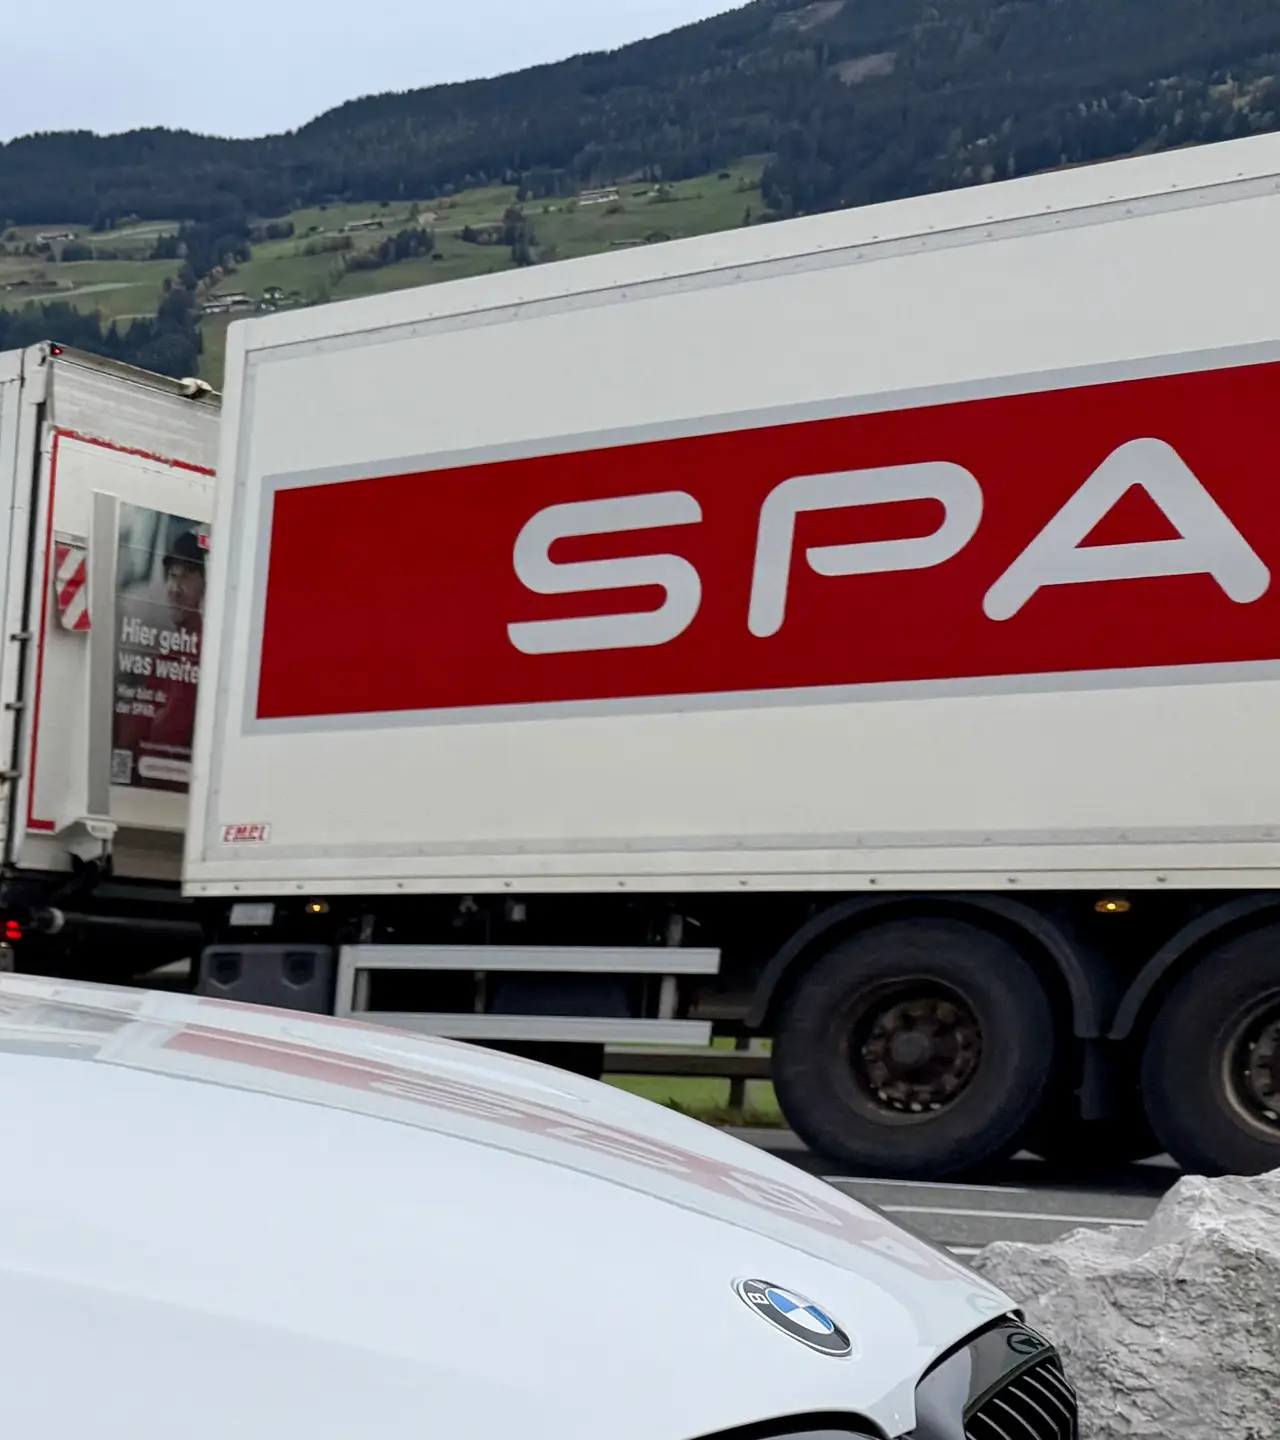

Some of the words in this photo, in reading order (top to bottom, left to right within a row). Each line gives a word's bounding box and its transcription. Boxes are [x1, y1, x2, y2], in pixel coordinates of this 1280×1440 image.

[507, 437, 1271, 654] SPA
[122, 616, 157, 646] Hier
[159, 627, 198, 655] geht
[119, 651, 152, 676] was
